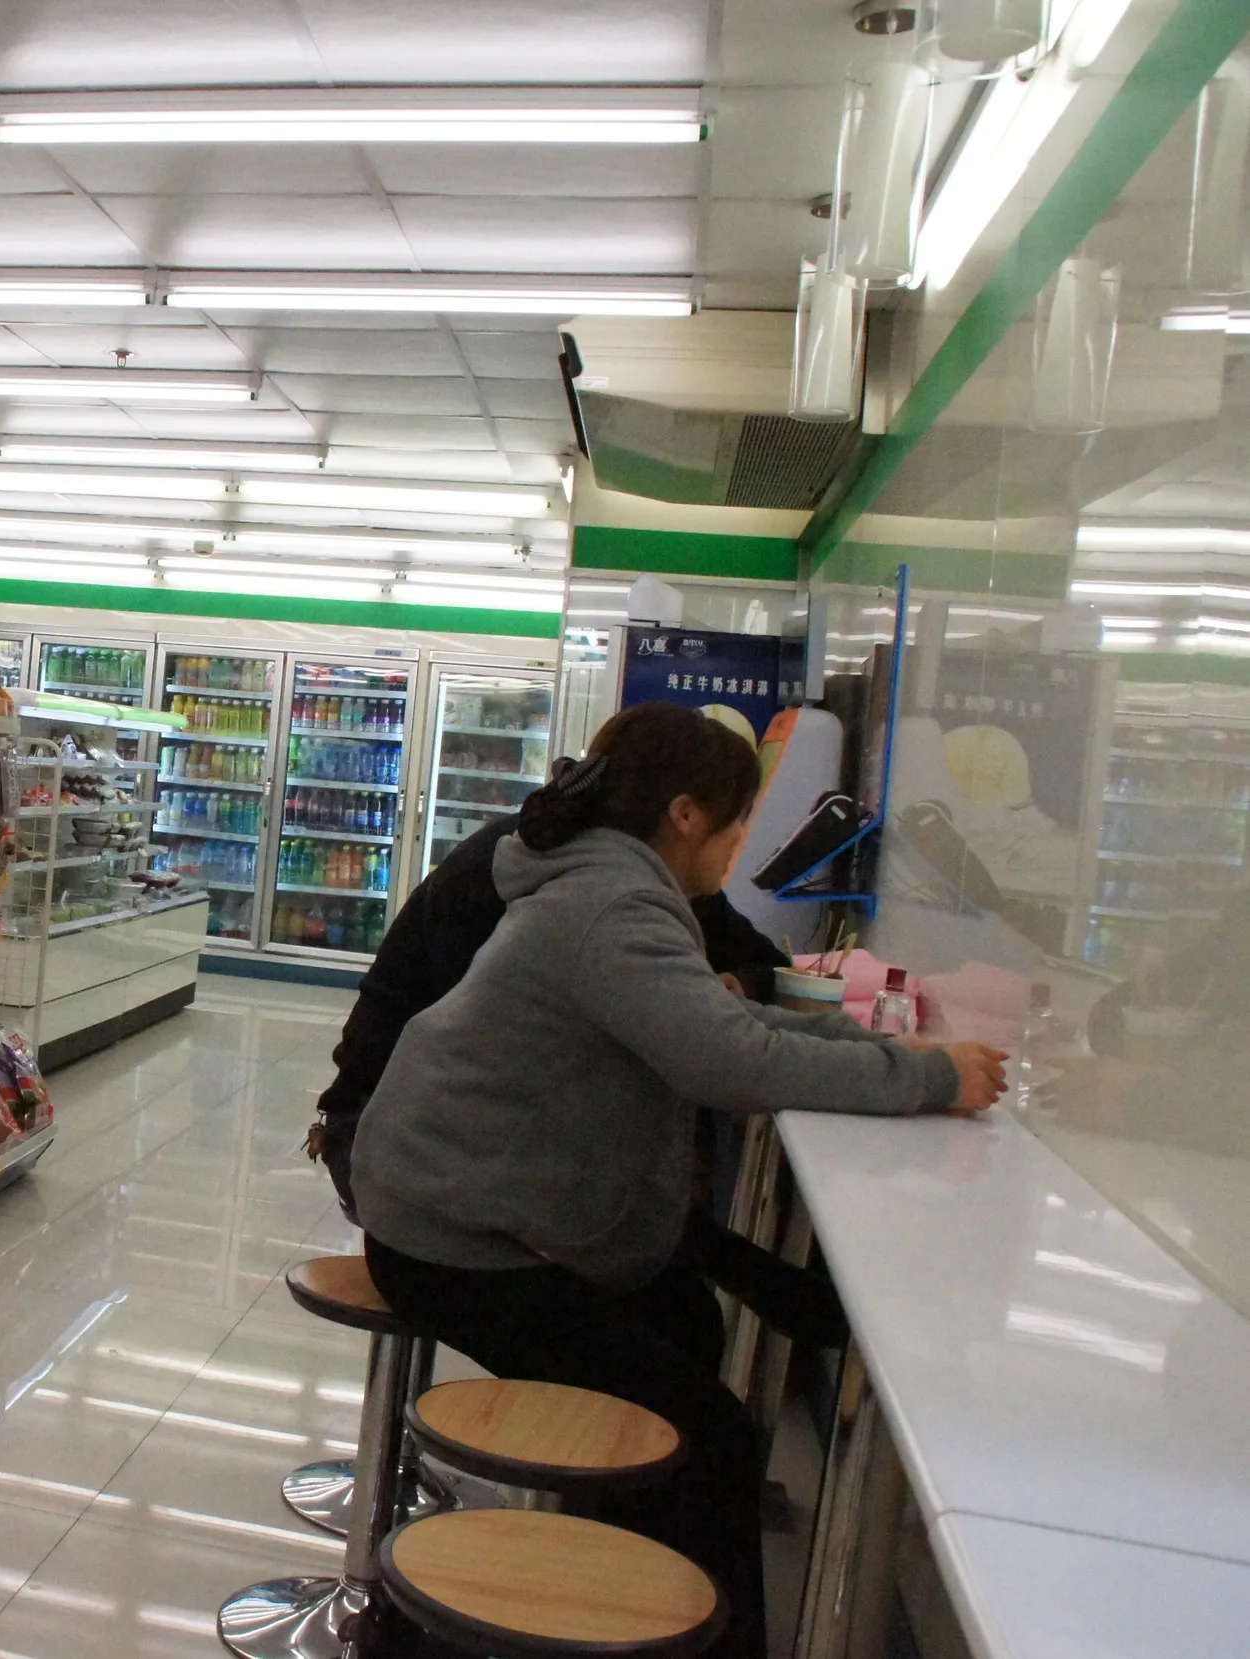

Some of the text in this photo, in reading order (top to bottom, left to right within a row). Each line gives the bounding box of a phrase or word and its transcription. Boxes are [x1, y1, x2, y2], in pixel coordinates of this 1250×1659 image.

[666, 671, 769, 697] 纯正牛奶冰淇淋
